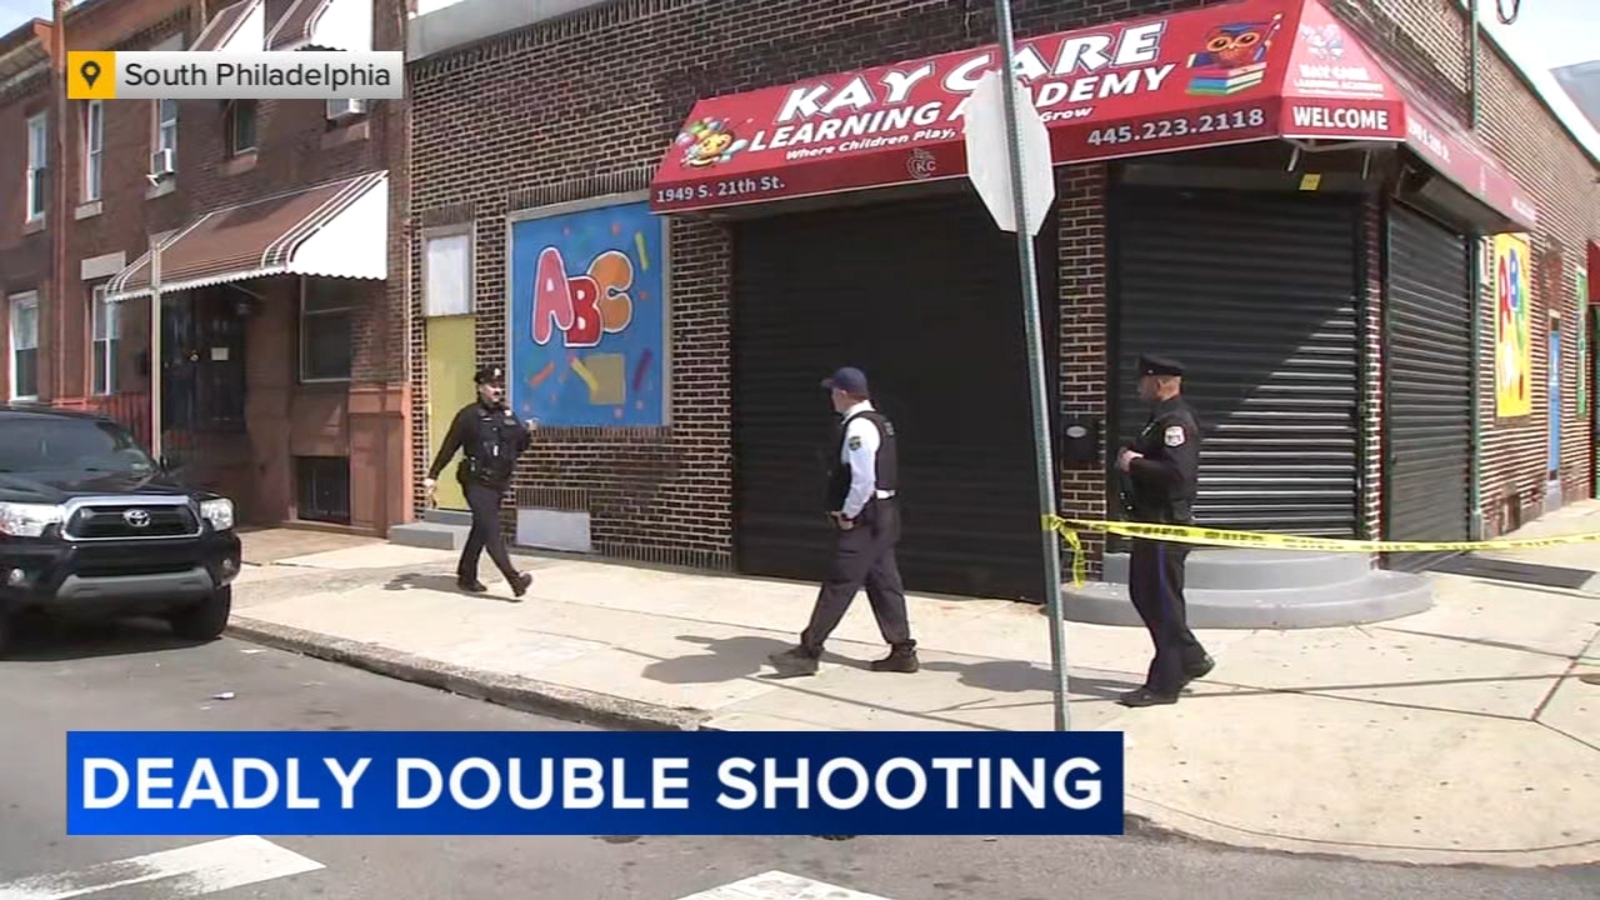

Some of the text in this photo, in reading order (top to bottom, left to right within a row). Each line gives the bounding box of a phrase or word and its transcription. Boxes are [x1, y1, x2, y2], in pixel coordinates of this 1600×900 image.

[777, 22, 1164, 123] KAY CARE
[747, 101, 941, 153] LEARNING
[786, 106, 1093, 161] Where Children Play, Grow
[1086, 108, 1265, 147] 445.223.2118
[1292, 105, 1389, 131] WELCOME
[656, 176, 786, 204] 1949 S. 21th St.
[532, 246, 635, 348] ABC
